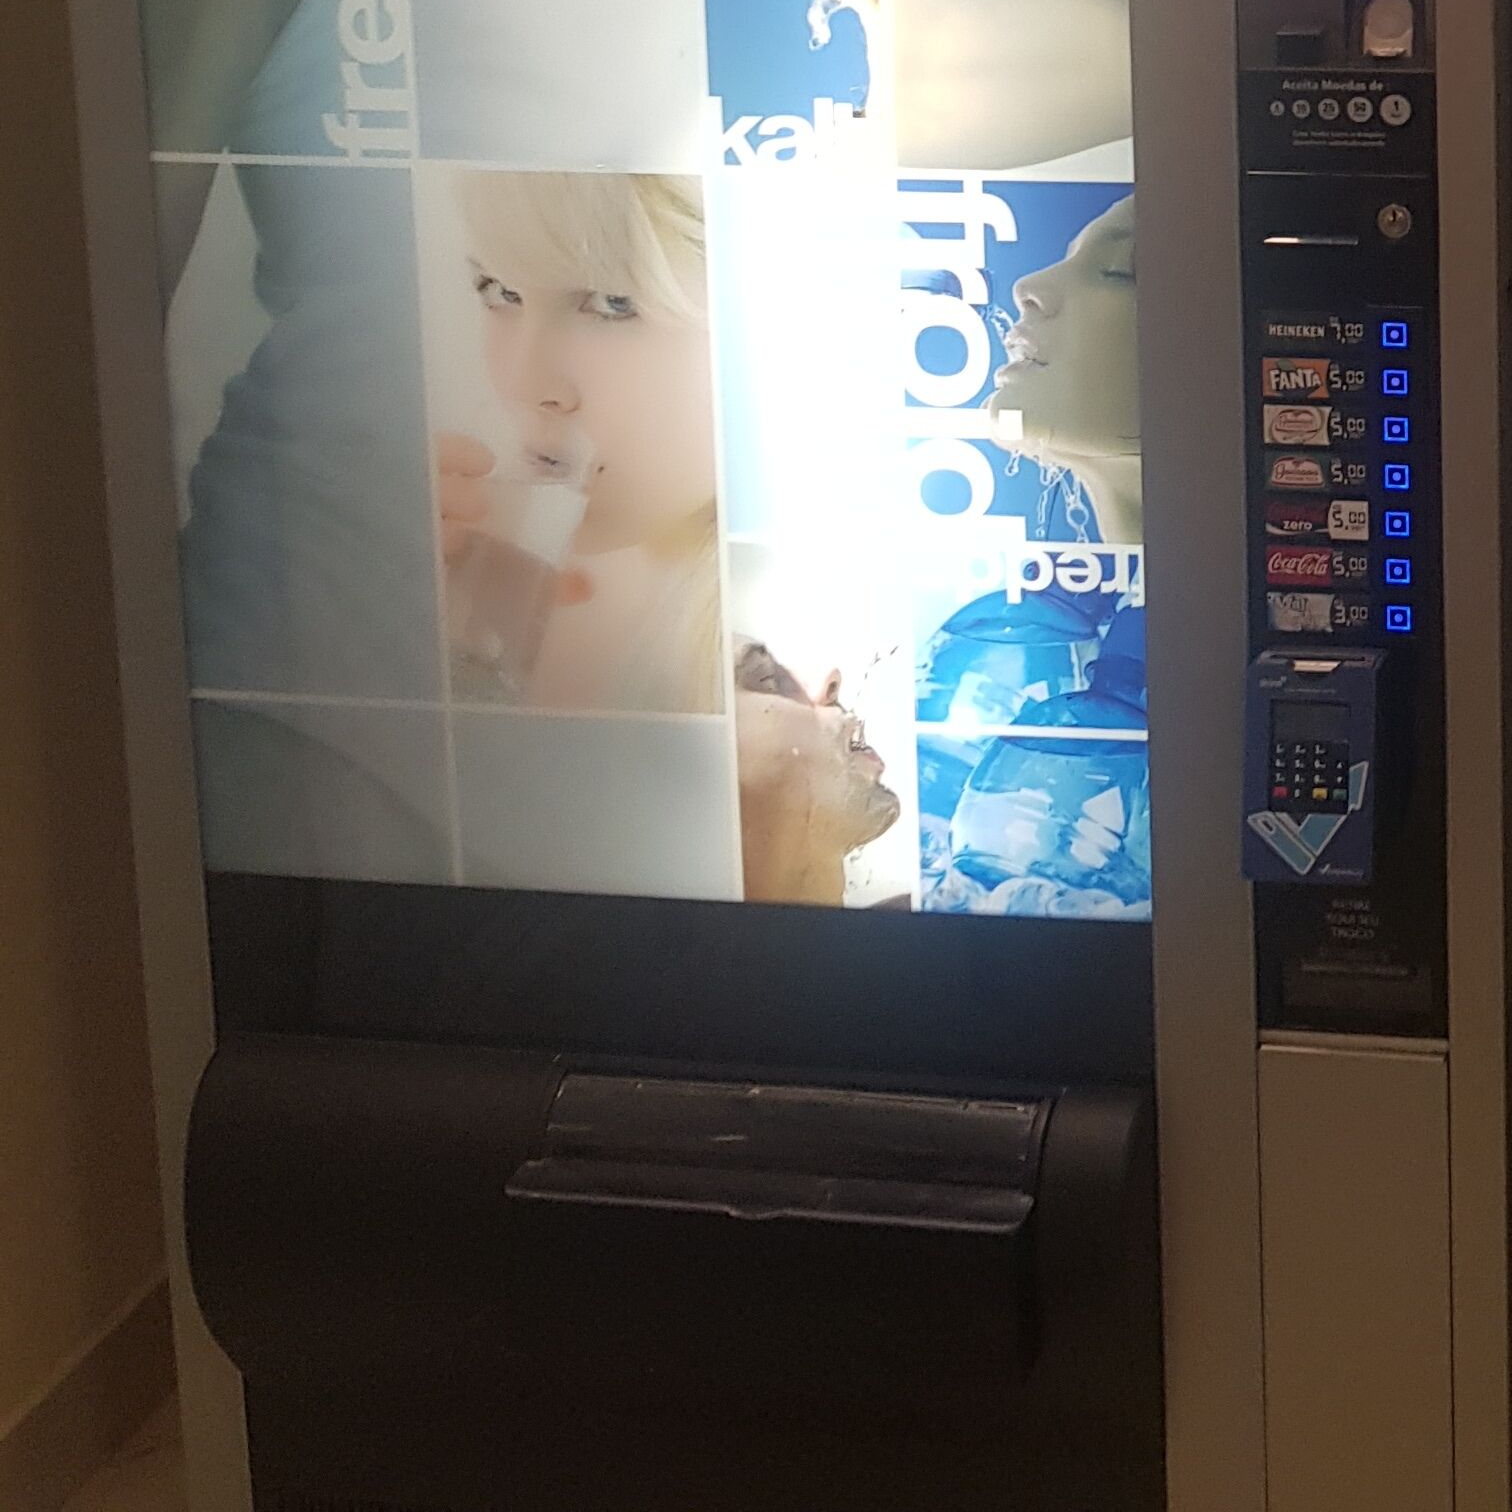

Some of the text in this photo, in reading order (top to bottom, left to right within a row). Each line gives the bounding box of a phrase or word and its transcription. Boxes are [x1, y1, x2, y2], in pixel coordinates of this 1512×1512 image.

[1268, 323, 1326, 338] HEINEKEN
[1268, 367, 1322, 391] FANTA
[1282, 520, 1313, 531] zero
